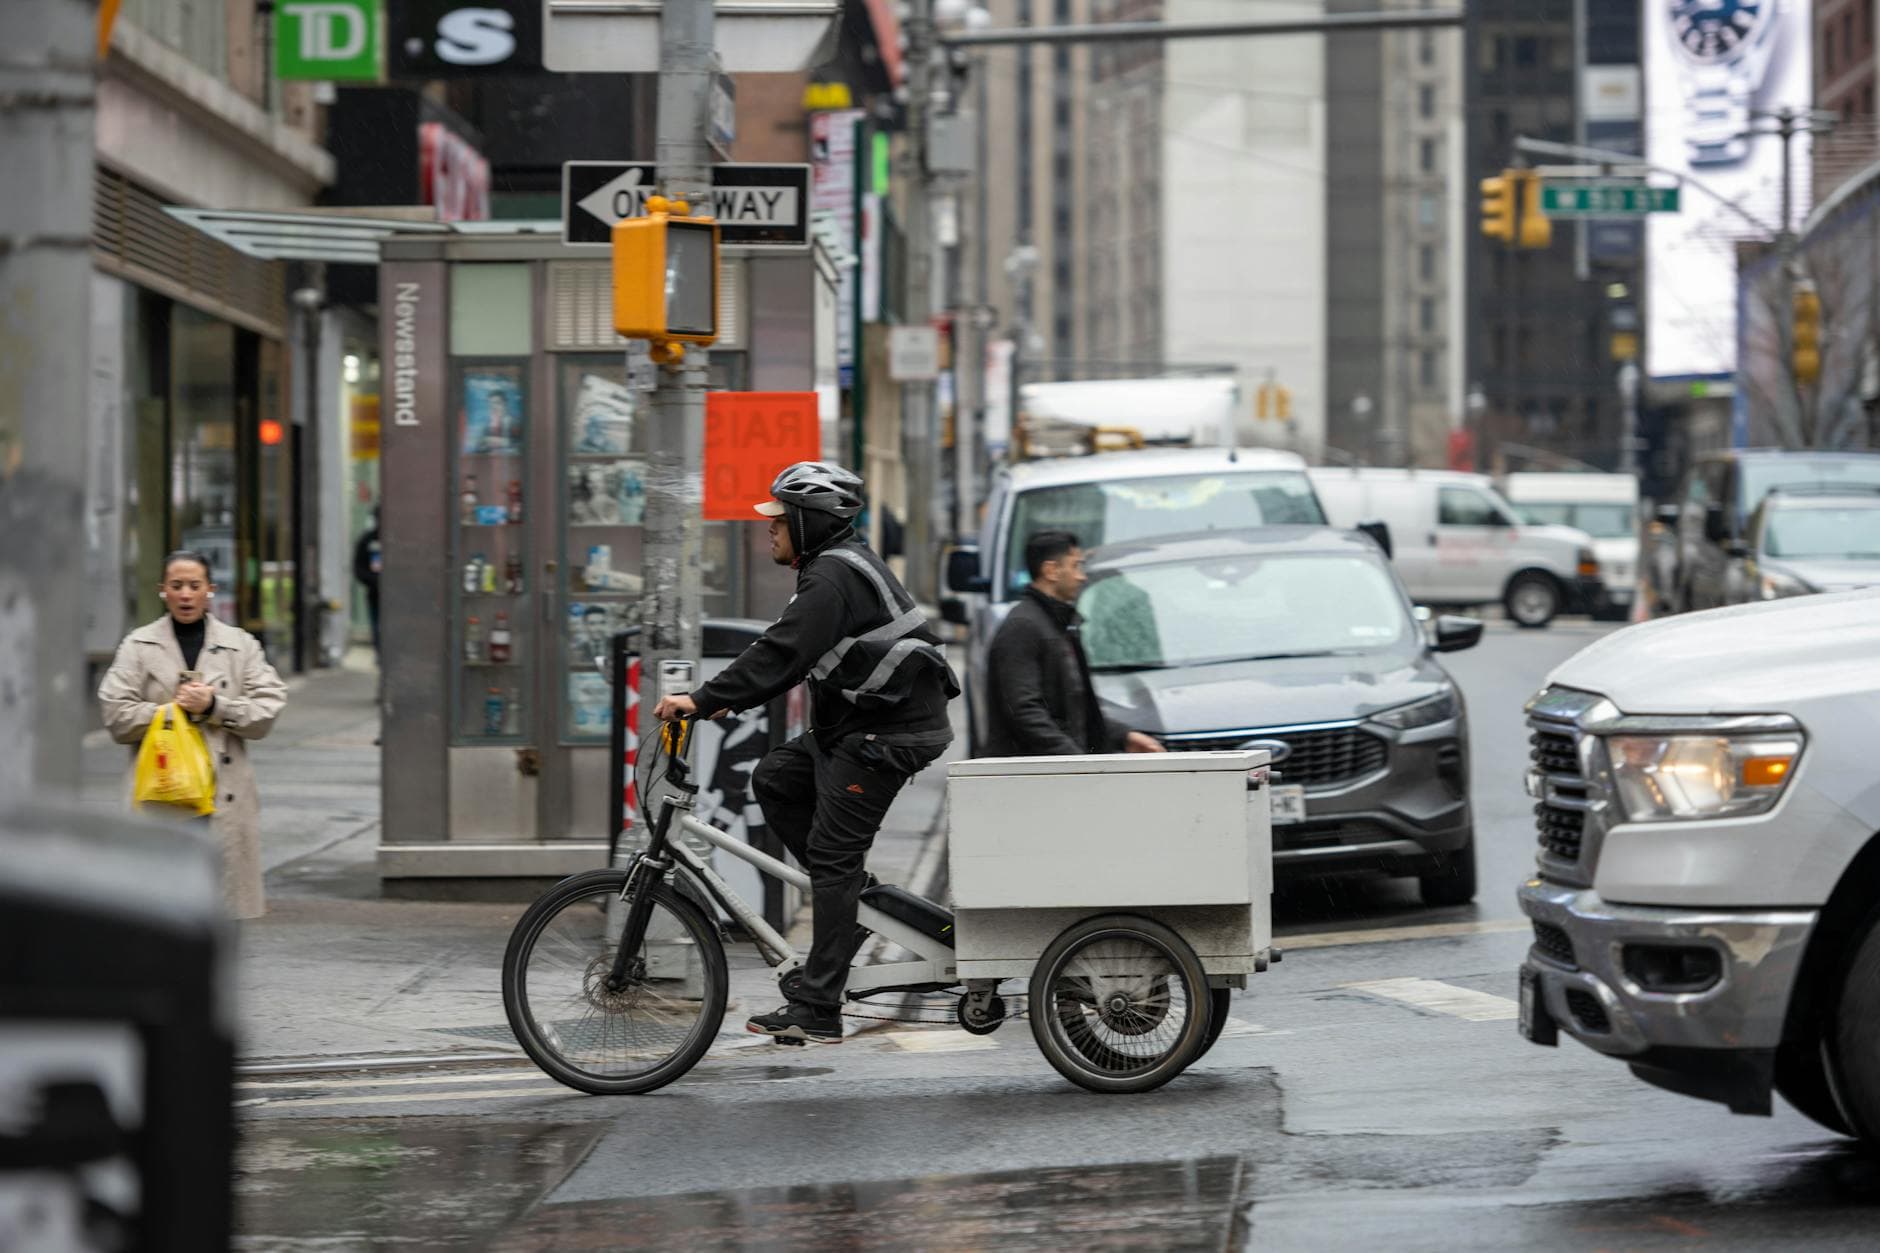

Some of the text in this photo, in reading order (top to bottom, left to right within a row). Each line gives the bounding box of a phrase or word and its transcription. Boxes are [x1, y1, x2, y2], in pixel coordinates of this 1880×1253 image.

[283, 4, 367, 60] TD
[612, 189, 784, 221] ON WAY
[394, 282, 420, 426] Newsstand
